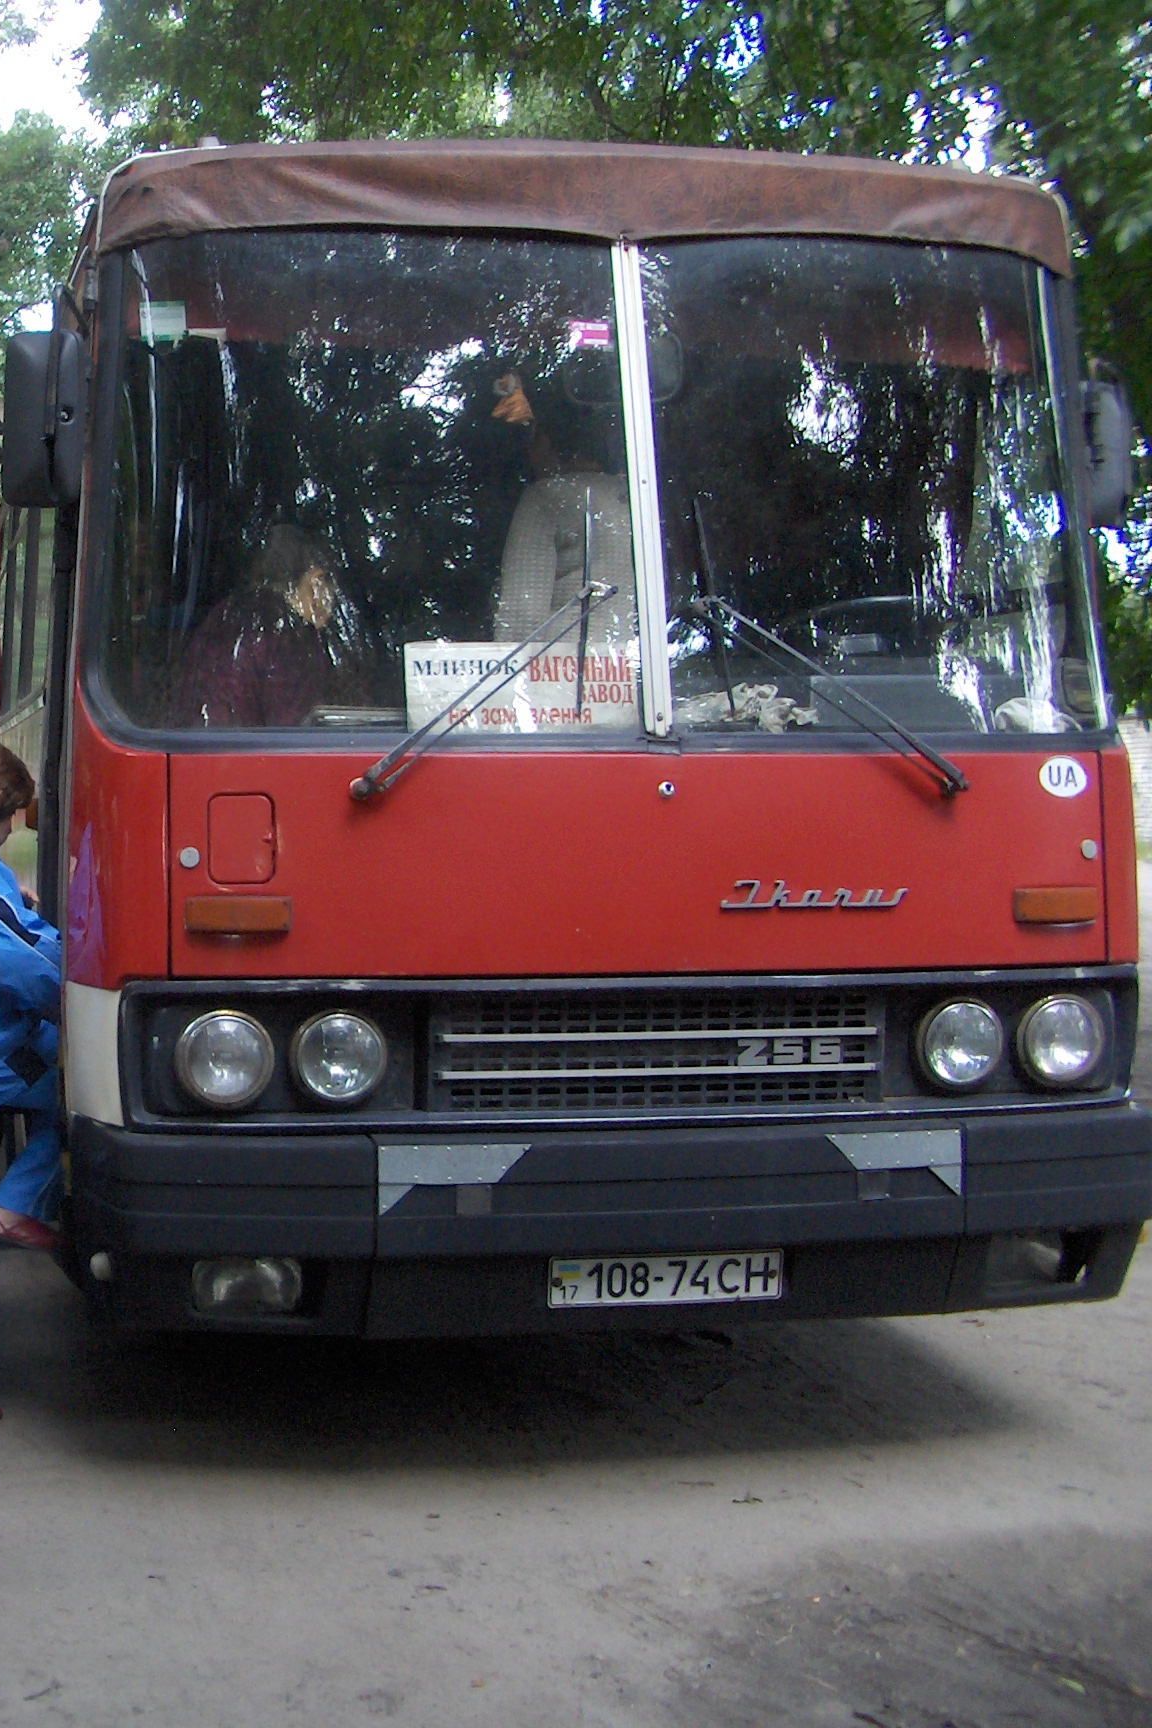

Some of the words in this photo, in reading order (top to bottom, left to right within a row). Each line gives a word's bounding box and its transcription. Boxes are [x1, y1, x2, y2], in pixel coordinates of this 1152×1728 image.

[480, 706, 591, 726] замвлення
[1048, 765, 1078, 788] UA
[720, 879, 909, 909] Ikarus
[737, 1037, 842, 1067] 256
[558, 1284, 579, 1300] 17
